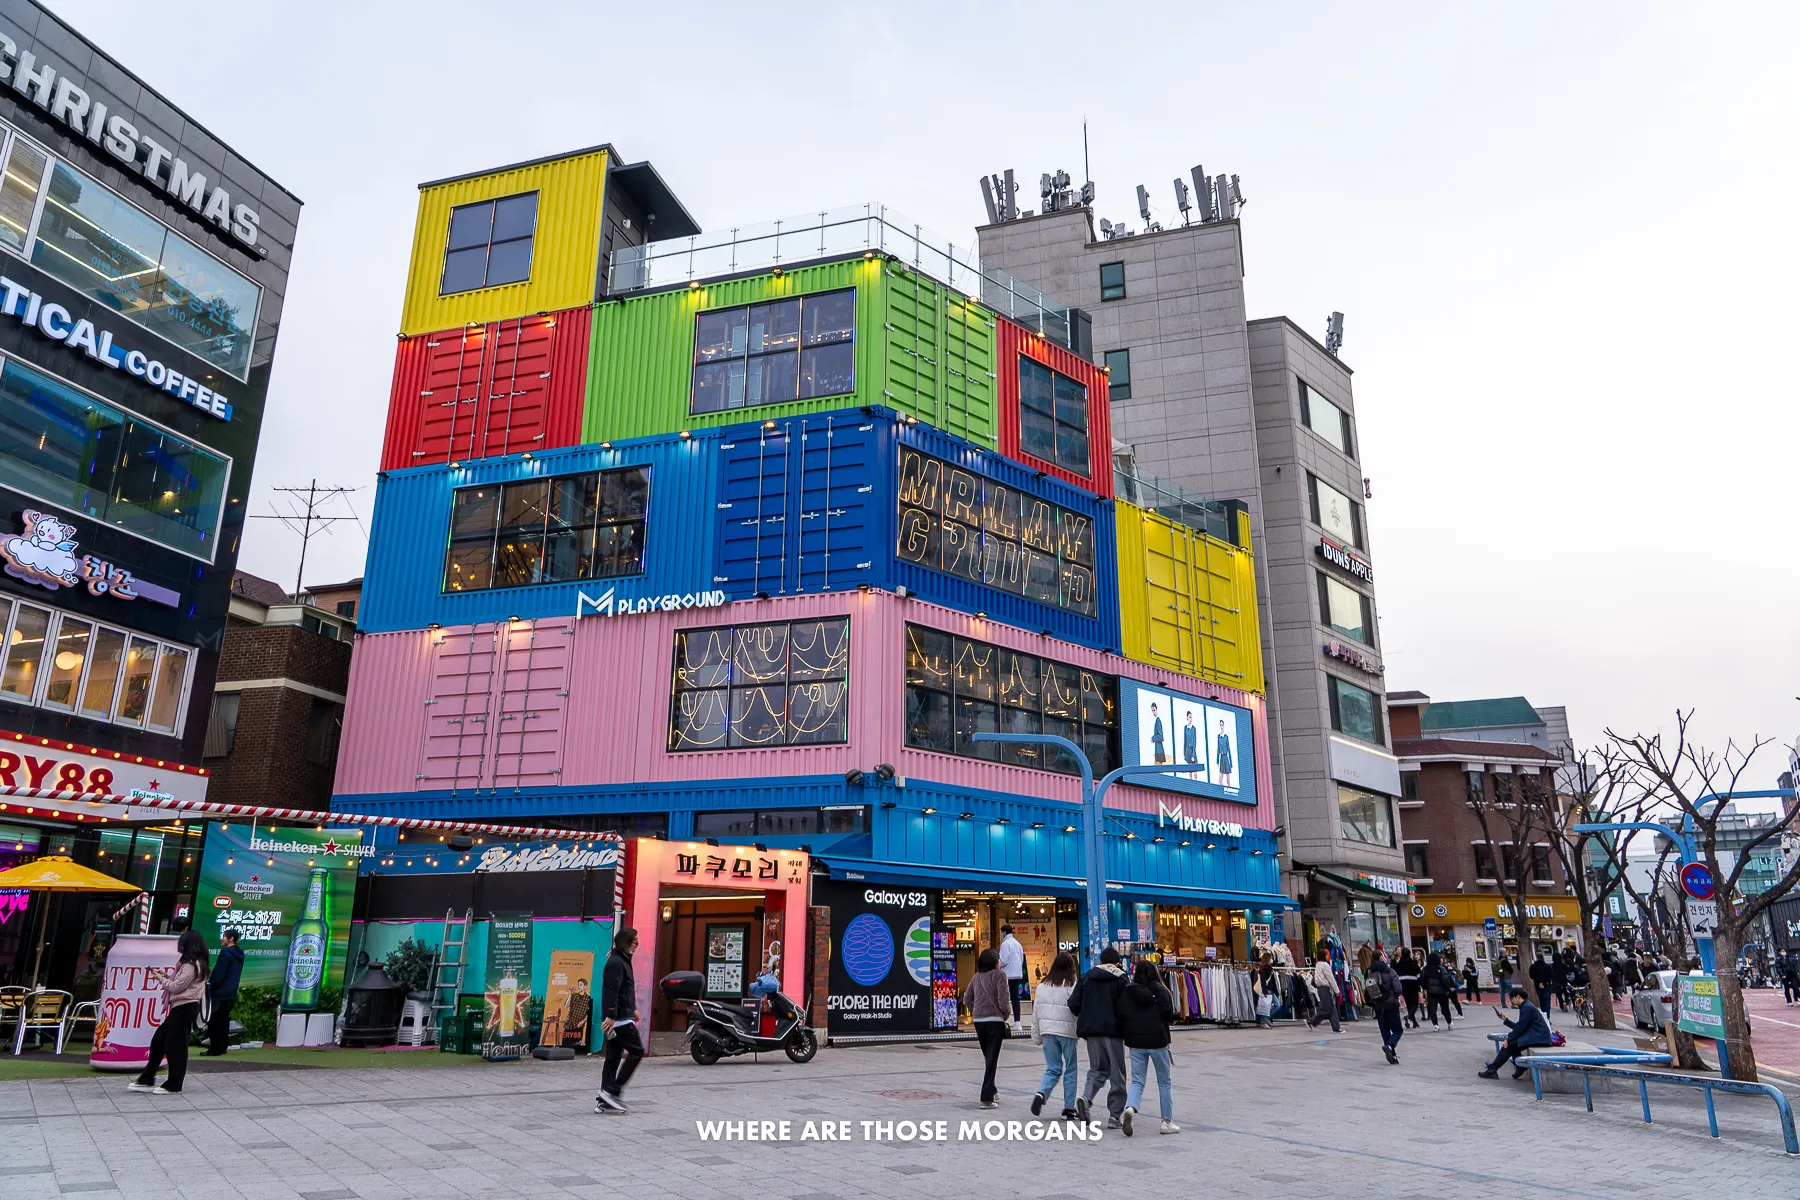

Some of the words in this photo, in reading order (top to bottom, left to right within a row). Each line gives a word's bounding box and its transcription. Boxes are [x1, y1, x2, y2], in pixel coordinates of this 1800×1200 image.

[124, 350, 229, 419] COFFEE
[617, 590, 726, 616] PLAYGROUND
[1184, 816, 1244, 838] PLAYGROUND
[248, 837, 318, 854] Heineken
[343, 844, 376, 858] SILVER
[676, 853, 779, 880] 파쿠모리
[237, 883, 272, 892] Heineken
[243, 892, 262, 900] SILVER
[864, 889, 908, 909] Galaxy
[908, 892, 927, 907] S23
[215, 909, 282, 925] 스무스하게
[1538, 904, 1555, 918] 101
[843, 1013, 861, 1021] Galaxy
